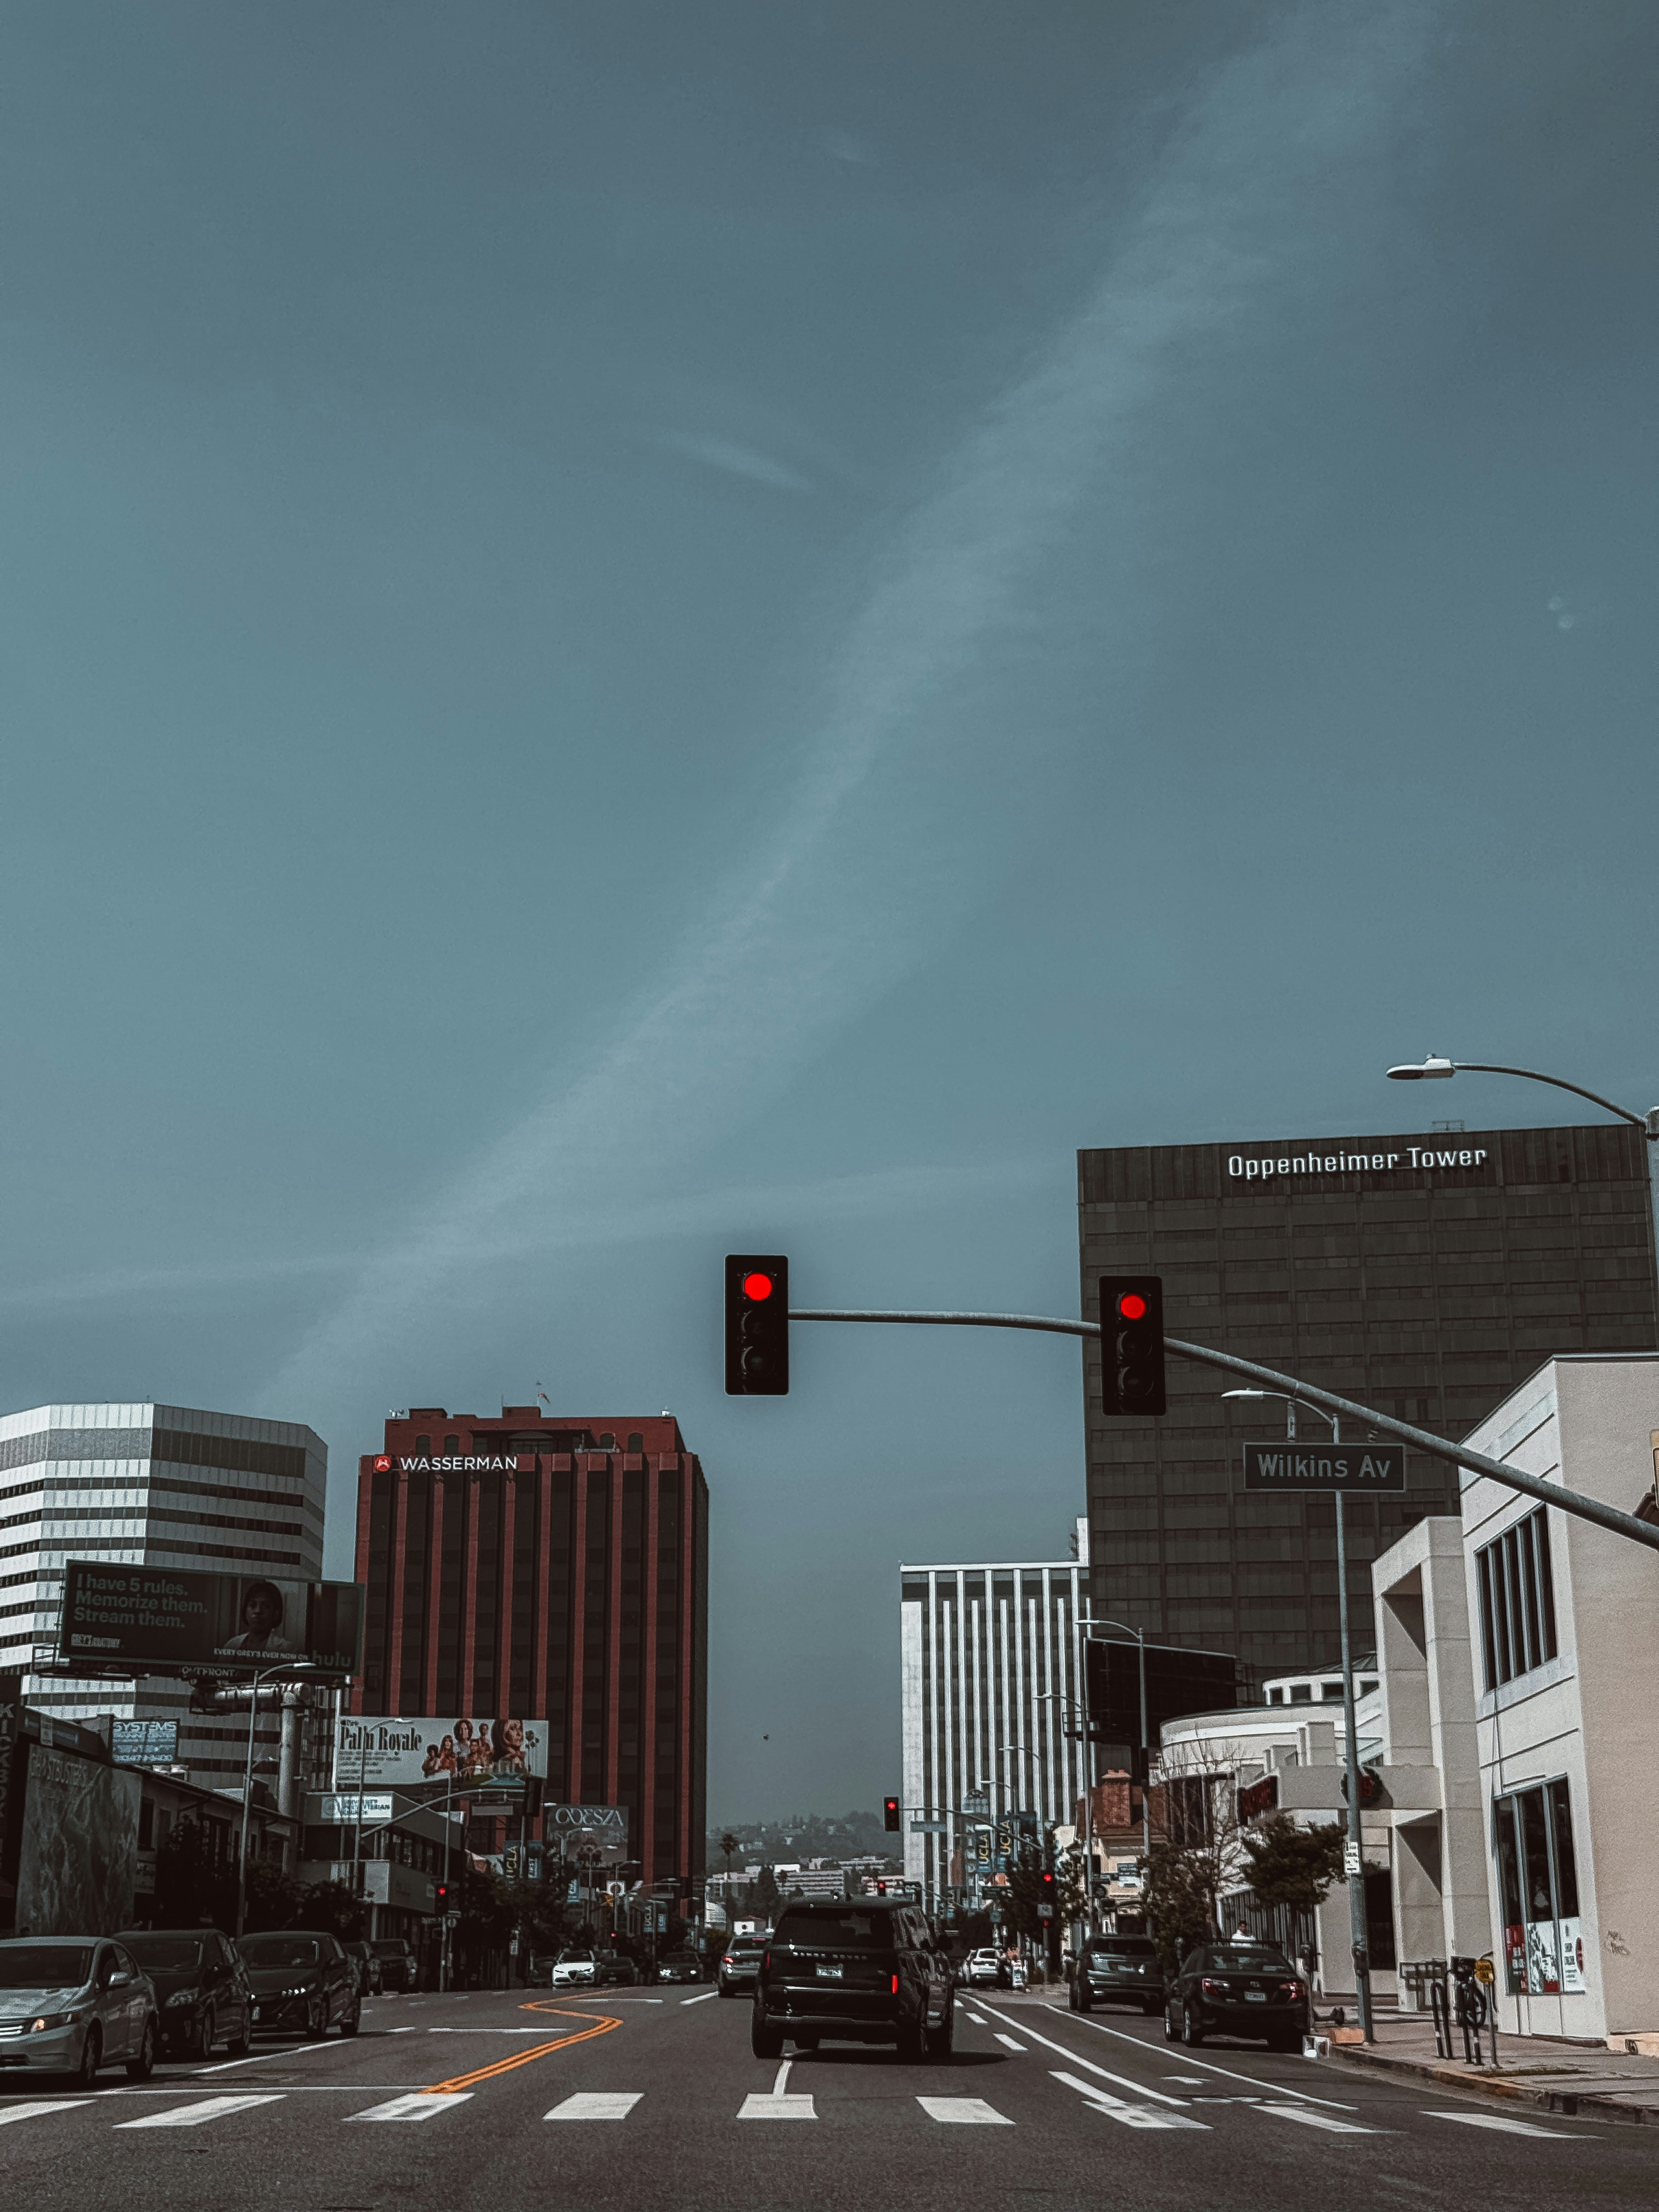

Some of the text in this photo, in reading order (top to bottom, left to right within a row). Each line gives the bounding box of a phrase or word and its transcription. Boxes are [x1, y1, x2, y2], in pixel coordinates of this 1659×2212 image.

[1227, 1147, 1488, 1181] Oppenheimer Tower
[400, 1456, 517, 1470] WASSERMAN
[1257, 1454, 1391, 1478] Wilkins Av
[77, 1573, 188, 1596] I have 5 rules.
[76, 1590, 208, 1613] Memorize them.
[74, 1606, 185, 1628] Stream them.
[312, 1650, 351, 1667] hulu
[113, 1722, 177, 1731] SYSTEMS
[379, 1727, 421, 1755] Royale
[555, 1807, 624, 1826] ODESZA
[978, 1833, 989, 1864] UCLA
[1000, 1820, 1011, 1855] UCLA
